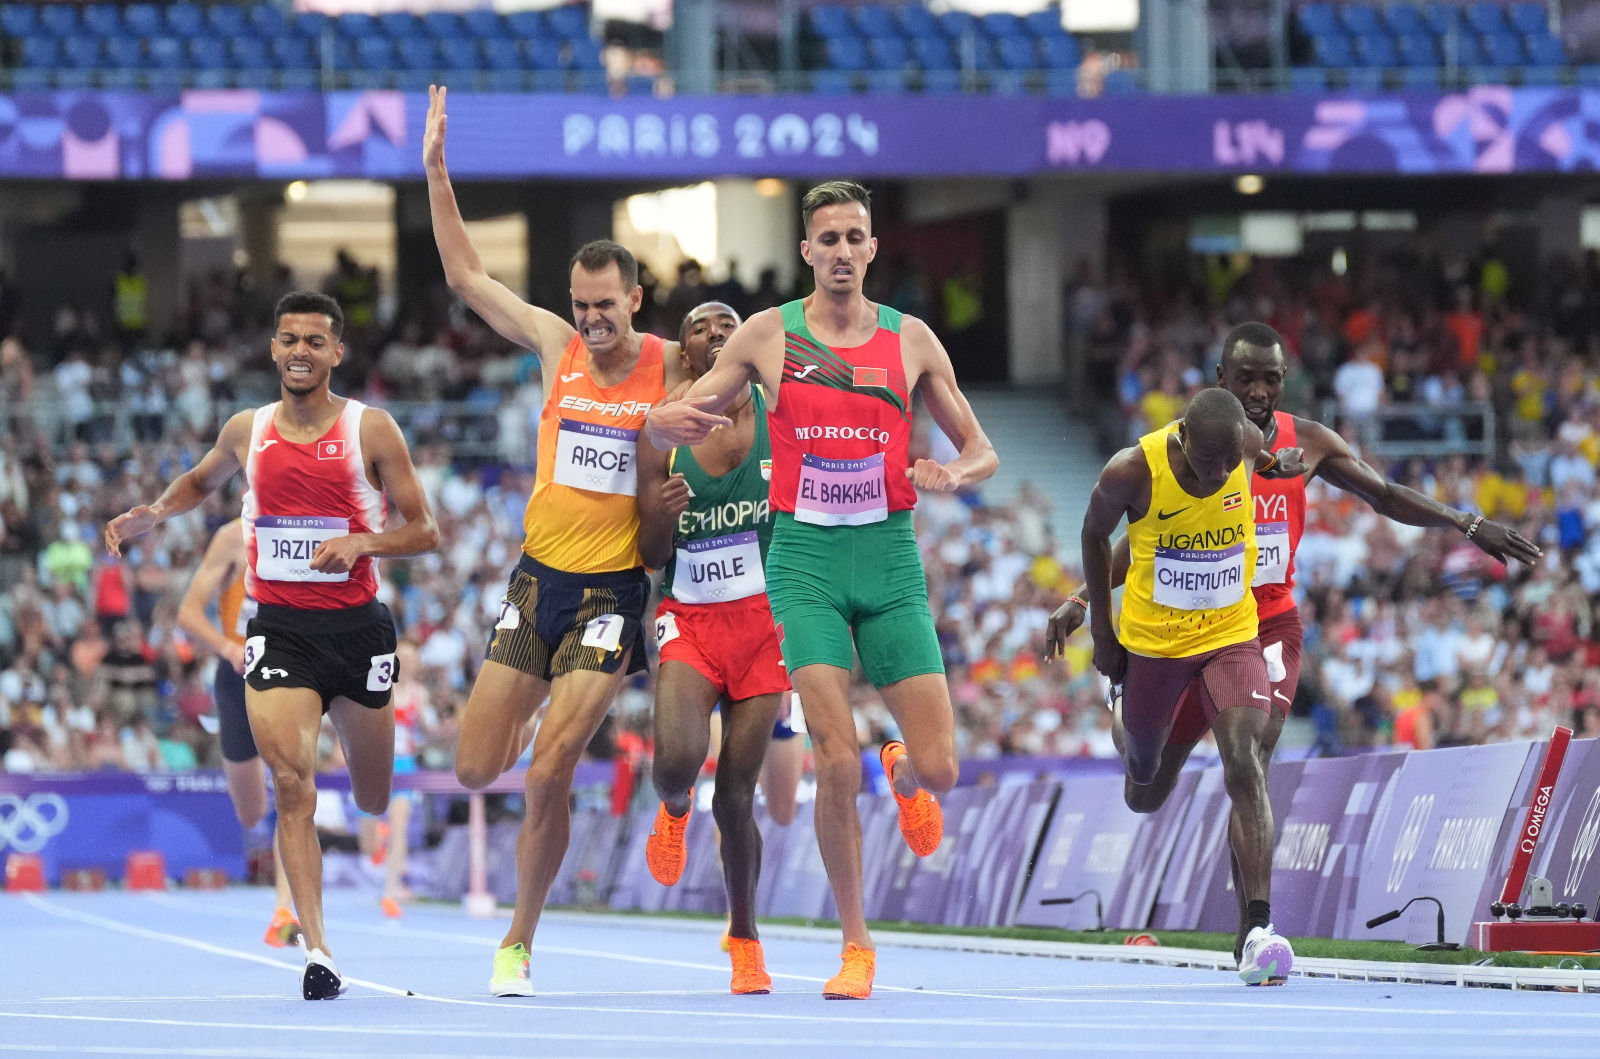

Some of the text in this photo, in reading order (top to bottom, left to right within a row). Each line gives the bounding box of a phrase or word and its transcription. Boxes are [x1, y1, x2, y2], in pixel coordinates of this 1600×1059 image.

[563, 112, 880, 158] PARIS 2024
[558, 395, 653, 417] ESPAÑA
[580, 424, 627, 438] PARIS 2024
[794, 425, 890, 444] MOROCCO
[571, 445, 630, 473] ARCE
[821, 461, 867, 470] PARIS 2024
[801, 477, 882, 504] EL BAKKALI
[276, 518, 301, 526] PARIS
[678, 498, 770, 534] ETHIOPIA
[687, 537, 733, 550] PARIS 2024
[1158, 523, 1246, 550] UGANDA
[688, 556, 745, 584] WALE
[1158, 564, 1241, 591] CHEMUTAI
[597, 620, 612, 640] 7
[377, 661, 392, 684] 3
[1527, 785, 1553, 837] OMEGA
